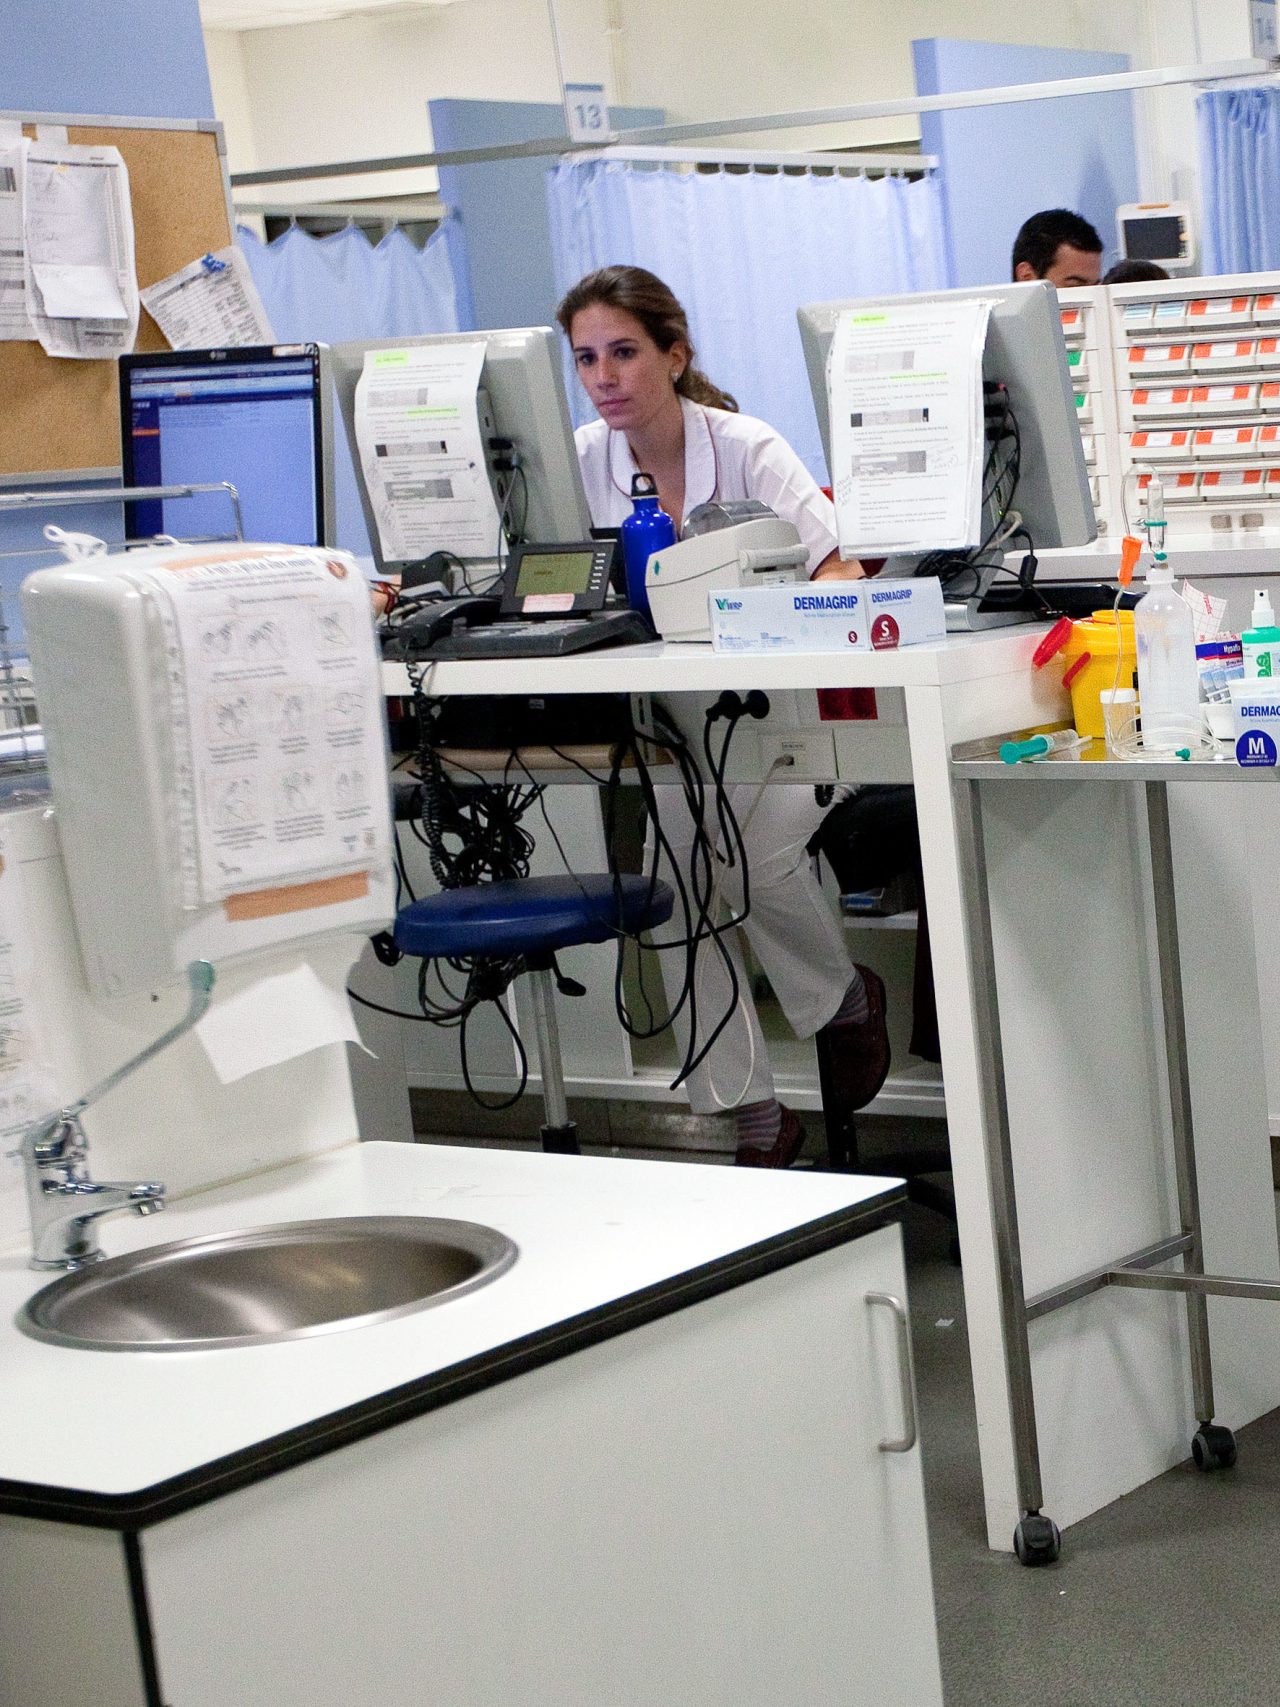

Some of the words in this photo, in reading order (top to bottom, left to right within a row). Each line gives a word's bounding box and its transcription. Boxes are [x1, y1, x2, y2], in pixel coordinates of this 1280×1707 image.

[576, 104, 602, 129] 13
[794, 595, 858, 610] DERMAGRIP
[872, 588, 912, 603] DERMAGRIP
[881, 620, 890, 637] S
[1248, 737, 1266, 755] M
